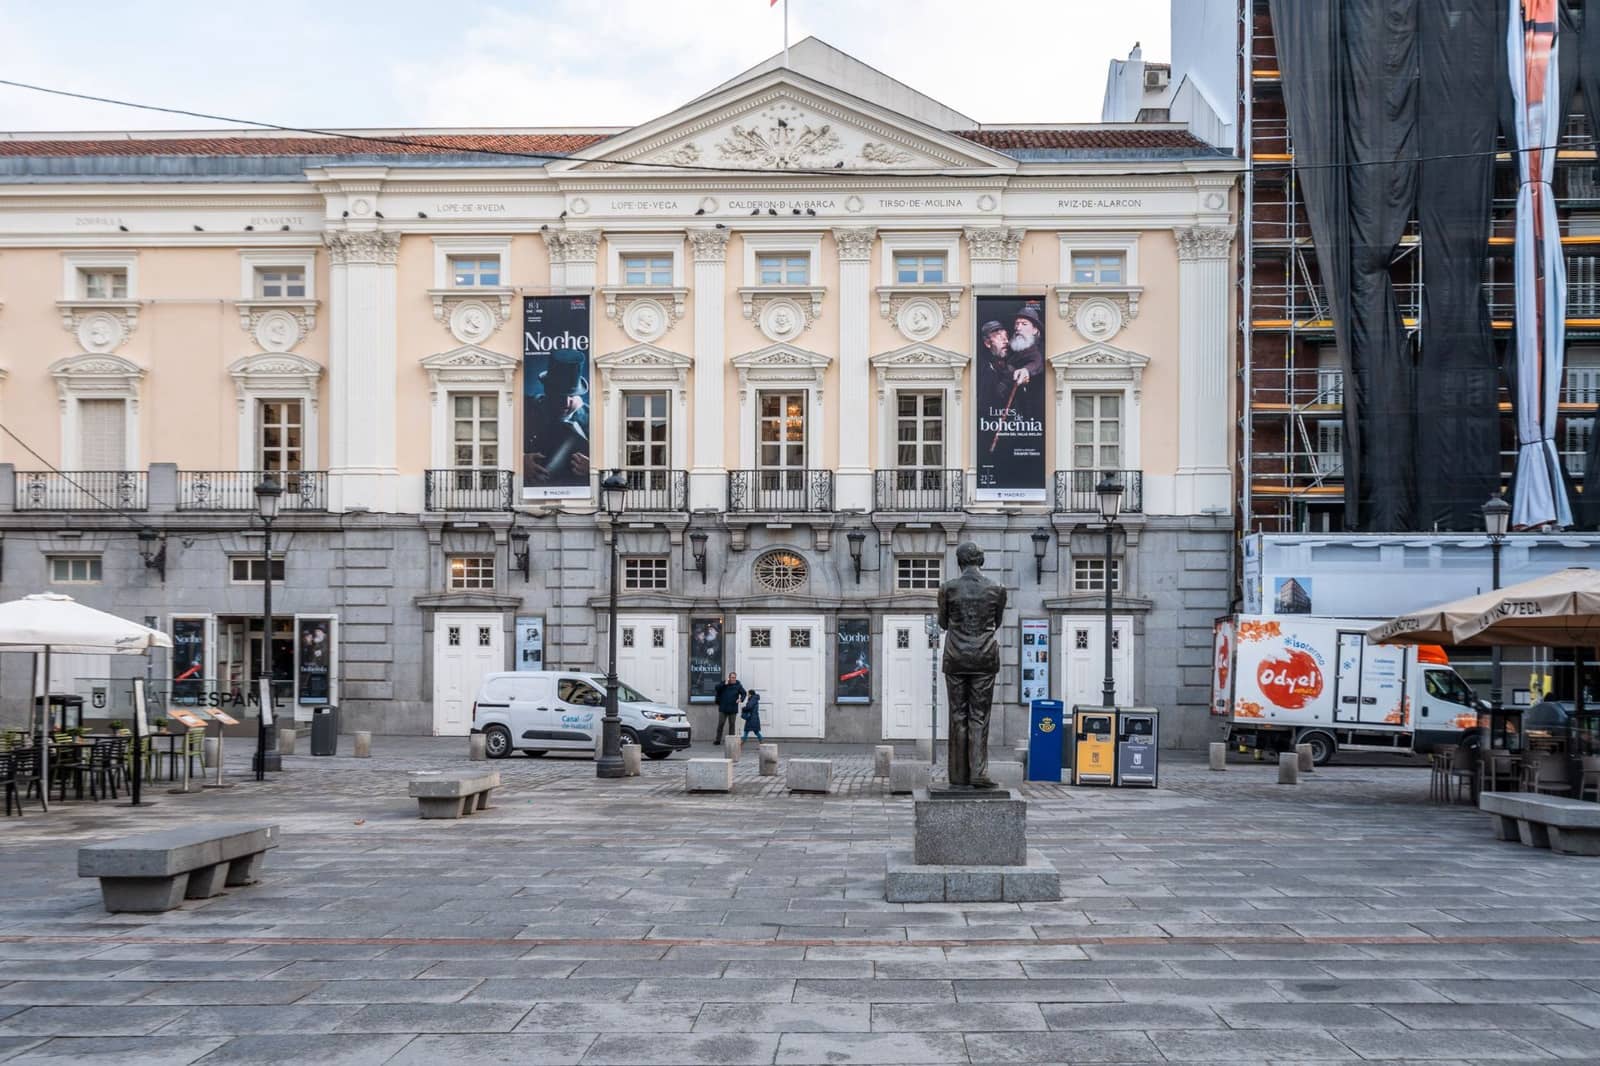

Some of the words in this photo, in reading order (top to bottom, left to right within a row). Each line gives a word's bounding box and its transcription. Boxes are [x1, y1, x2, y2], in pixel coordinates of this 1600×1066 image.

[525, 331, 589, 351] Noche
[989, 406, 1017, 417] Luces
[980, 417, 1043, 432] bohemia
[838, 632, 870, 642] Noche
[1292, 638, 1325, 667] isotermo
[1260, 669, 1316, 694] Odyel
[561, 714, 580, 722] Canal
